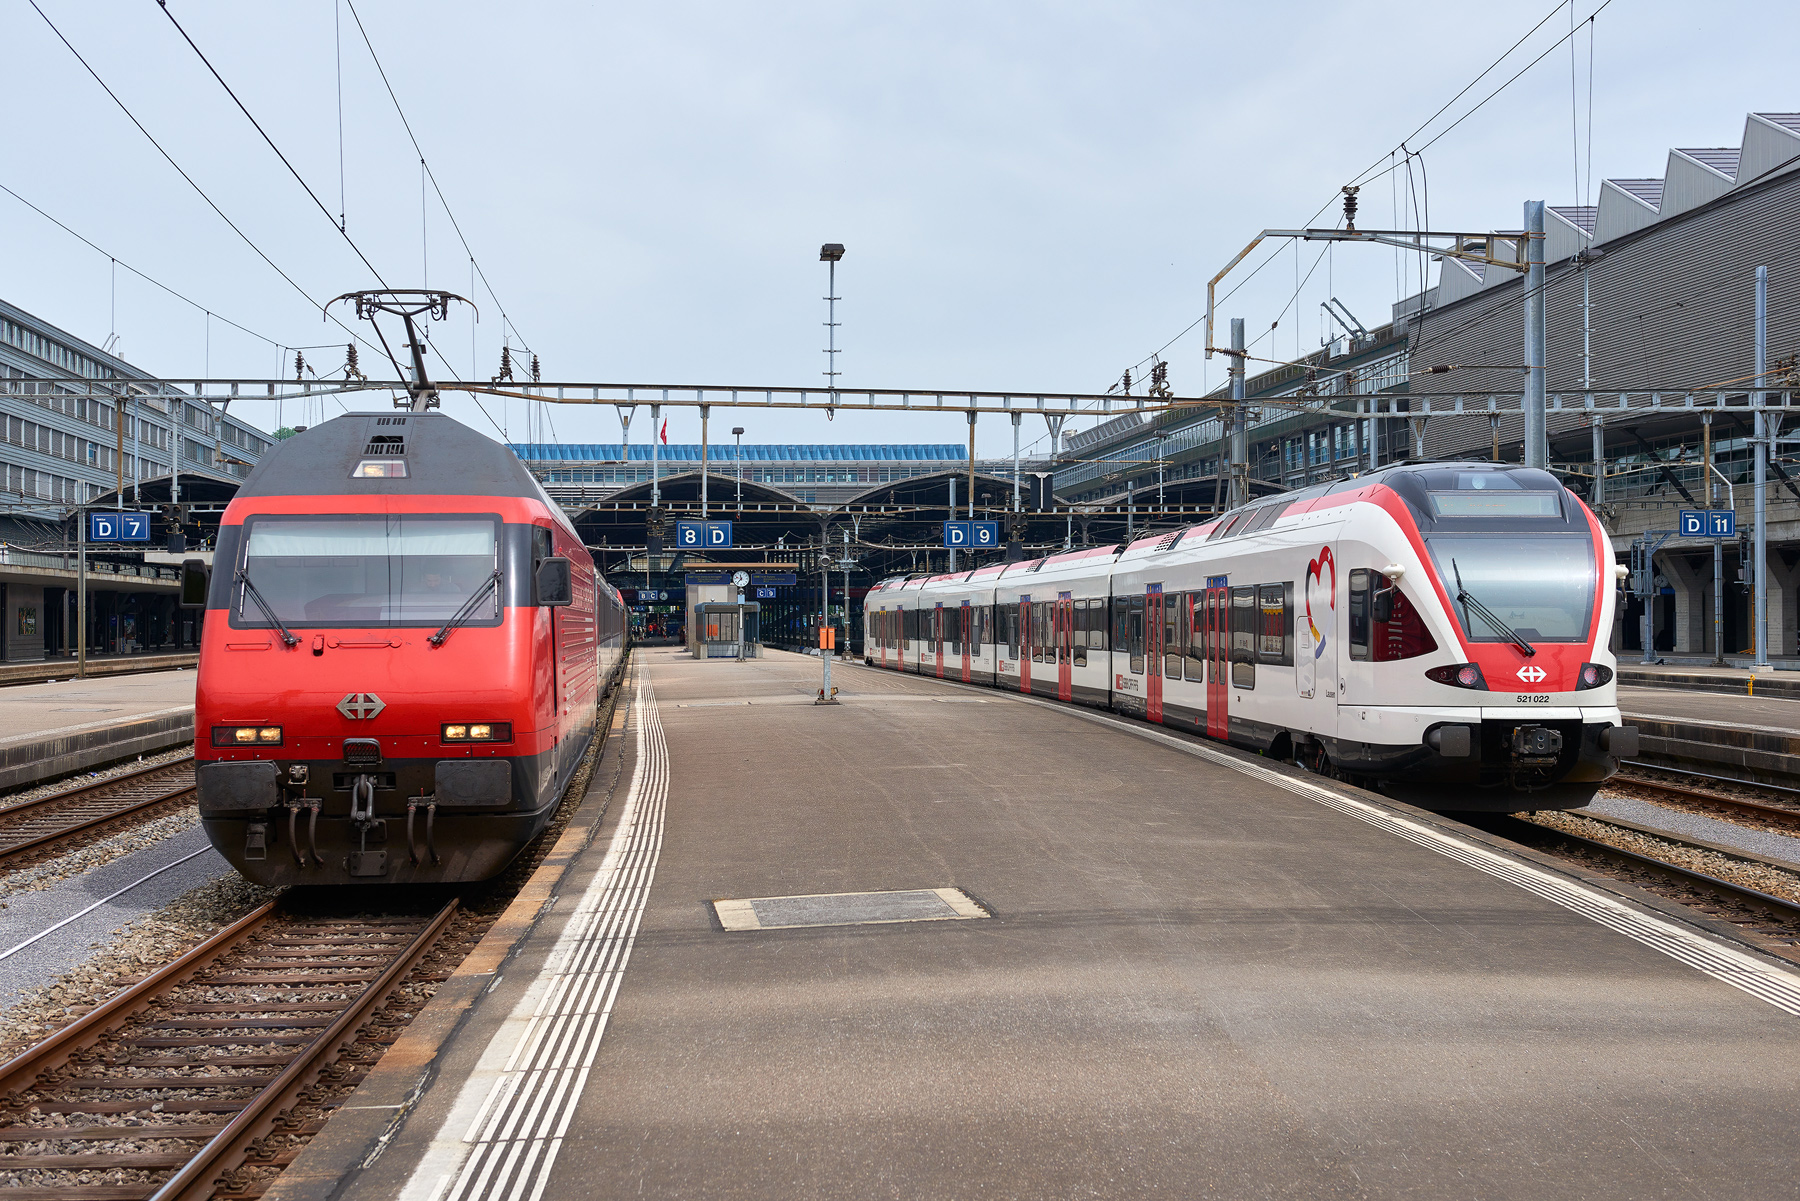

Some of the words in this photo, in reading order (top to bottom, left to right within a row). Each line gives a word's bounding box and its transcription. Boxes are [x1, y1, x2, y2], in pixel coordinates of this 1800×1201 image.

[99, 522, 112, 536] D
[129, 522, 140, 536] 7
[1688, 519, 1700, 532] D
[1715, 519, 1728, 532] 11
[685, 530, 696, 544] 8
[712, 530, 725, 544] D
[952, 530, 963, 543] D
[980, 530, 990, 543] 9
[1517, 695, 1531, 703] 521
[1533, 695, 1549, 703] 022
